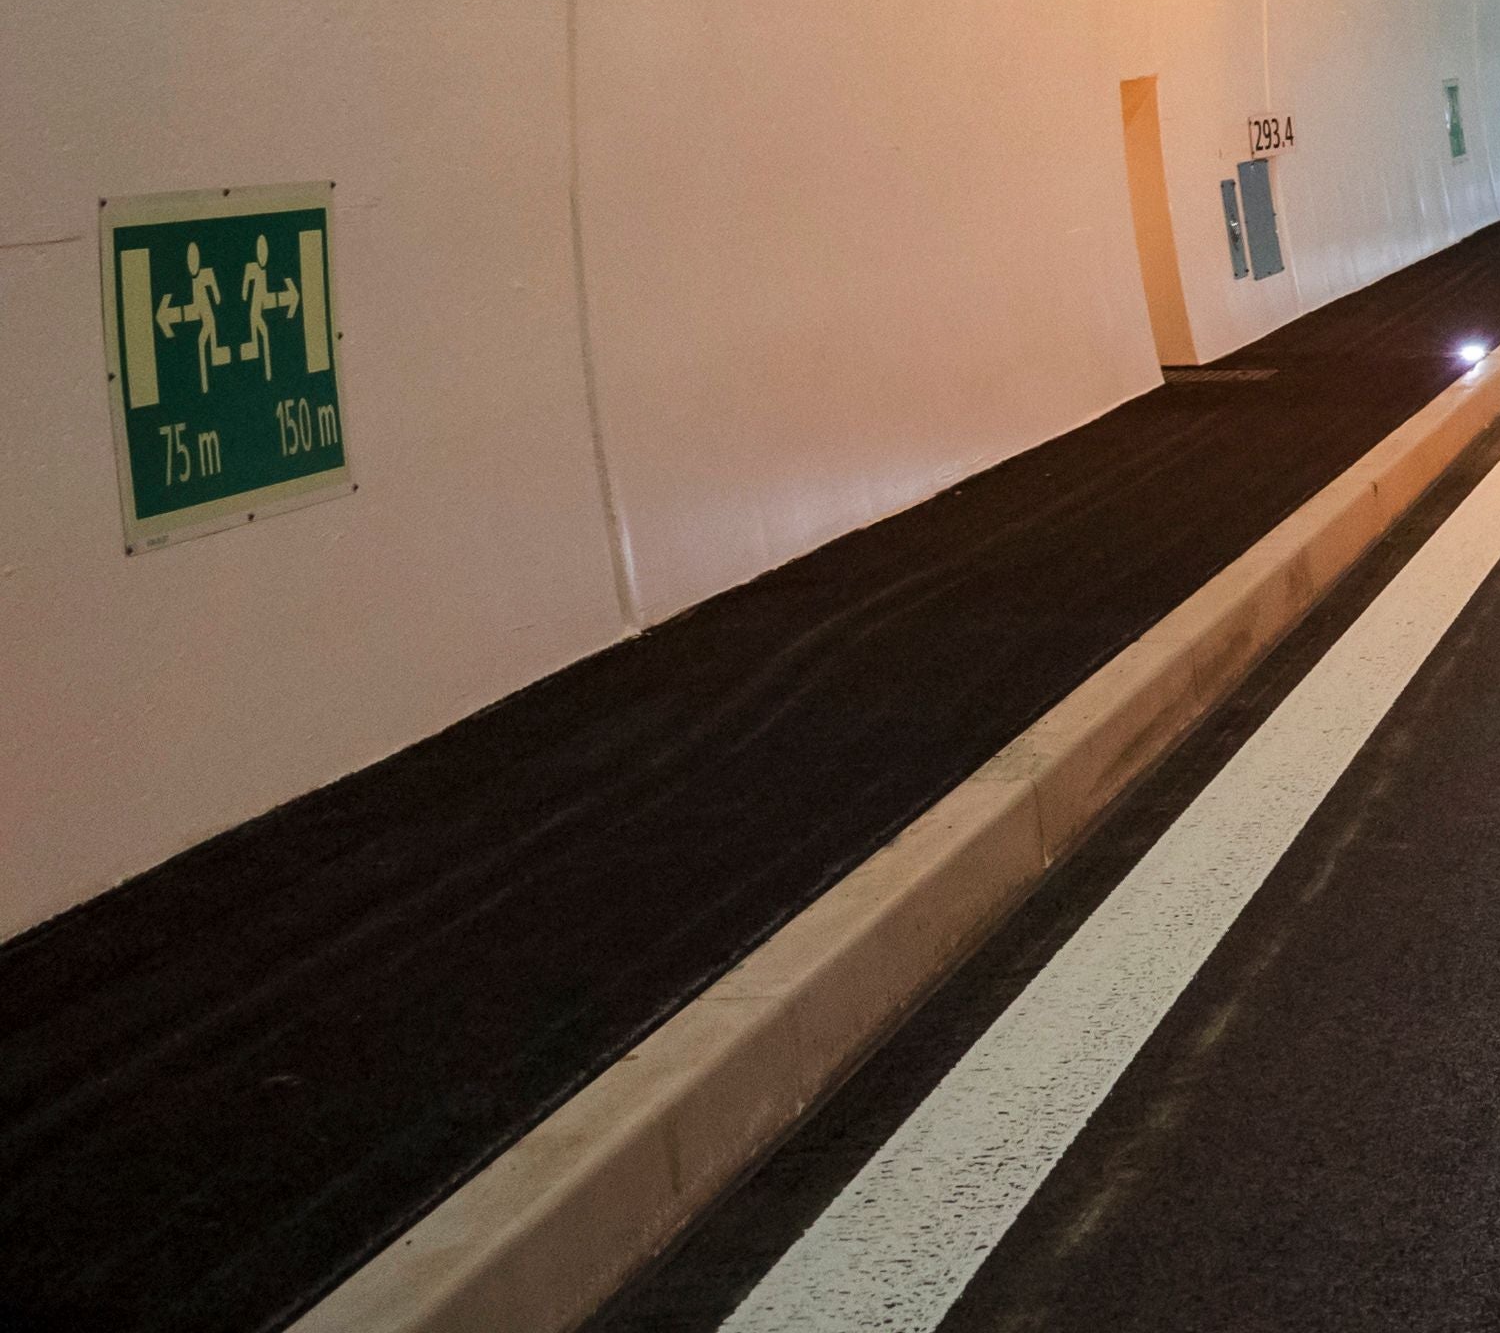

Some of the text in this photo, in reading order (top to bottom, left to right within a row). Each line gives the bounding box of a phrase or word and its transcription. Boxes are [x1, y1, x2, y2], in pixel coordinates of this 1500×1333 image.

[1254, 116, 1294, 151] 293.4
[159, 421, 221, 486] 75 m
[276, 397, 338, 456] 150 m
